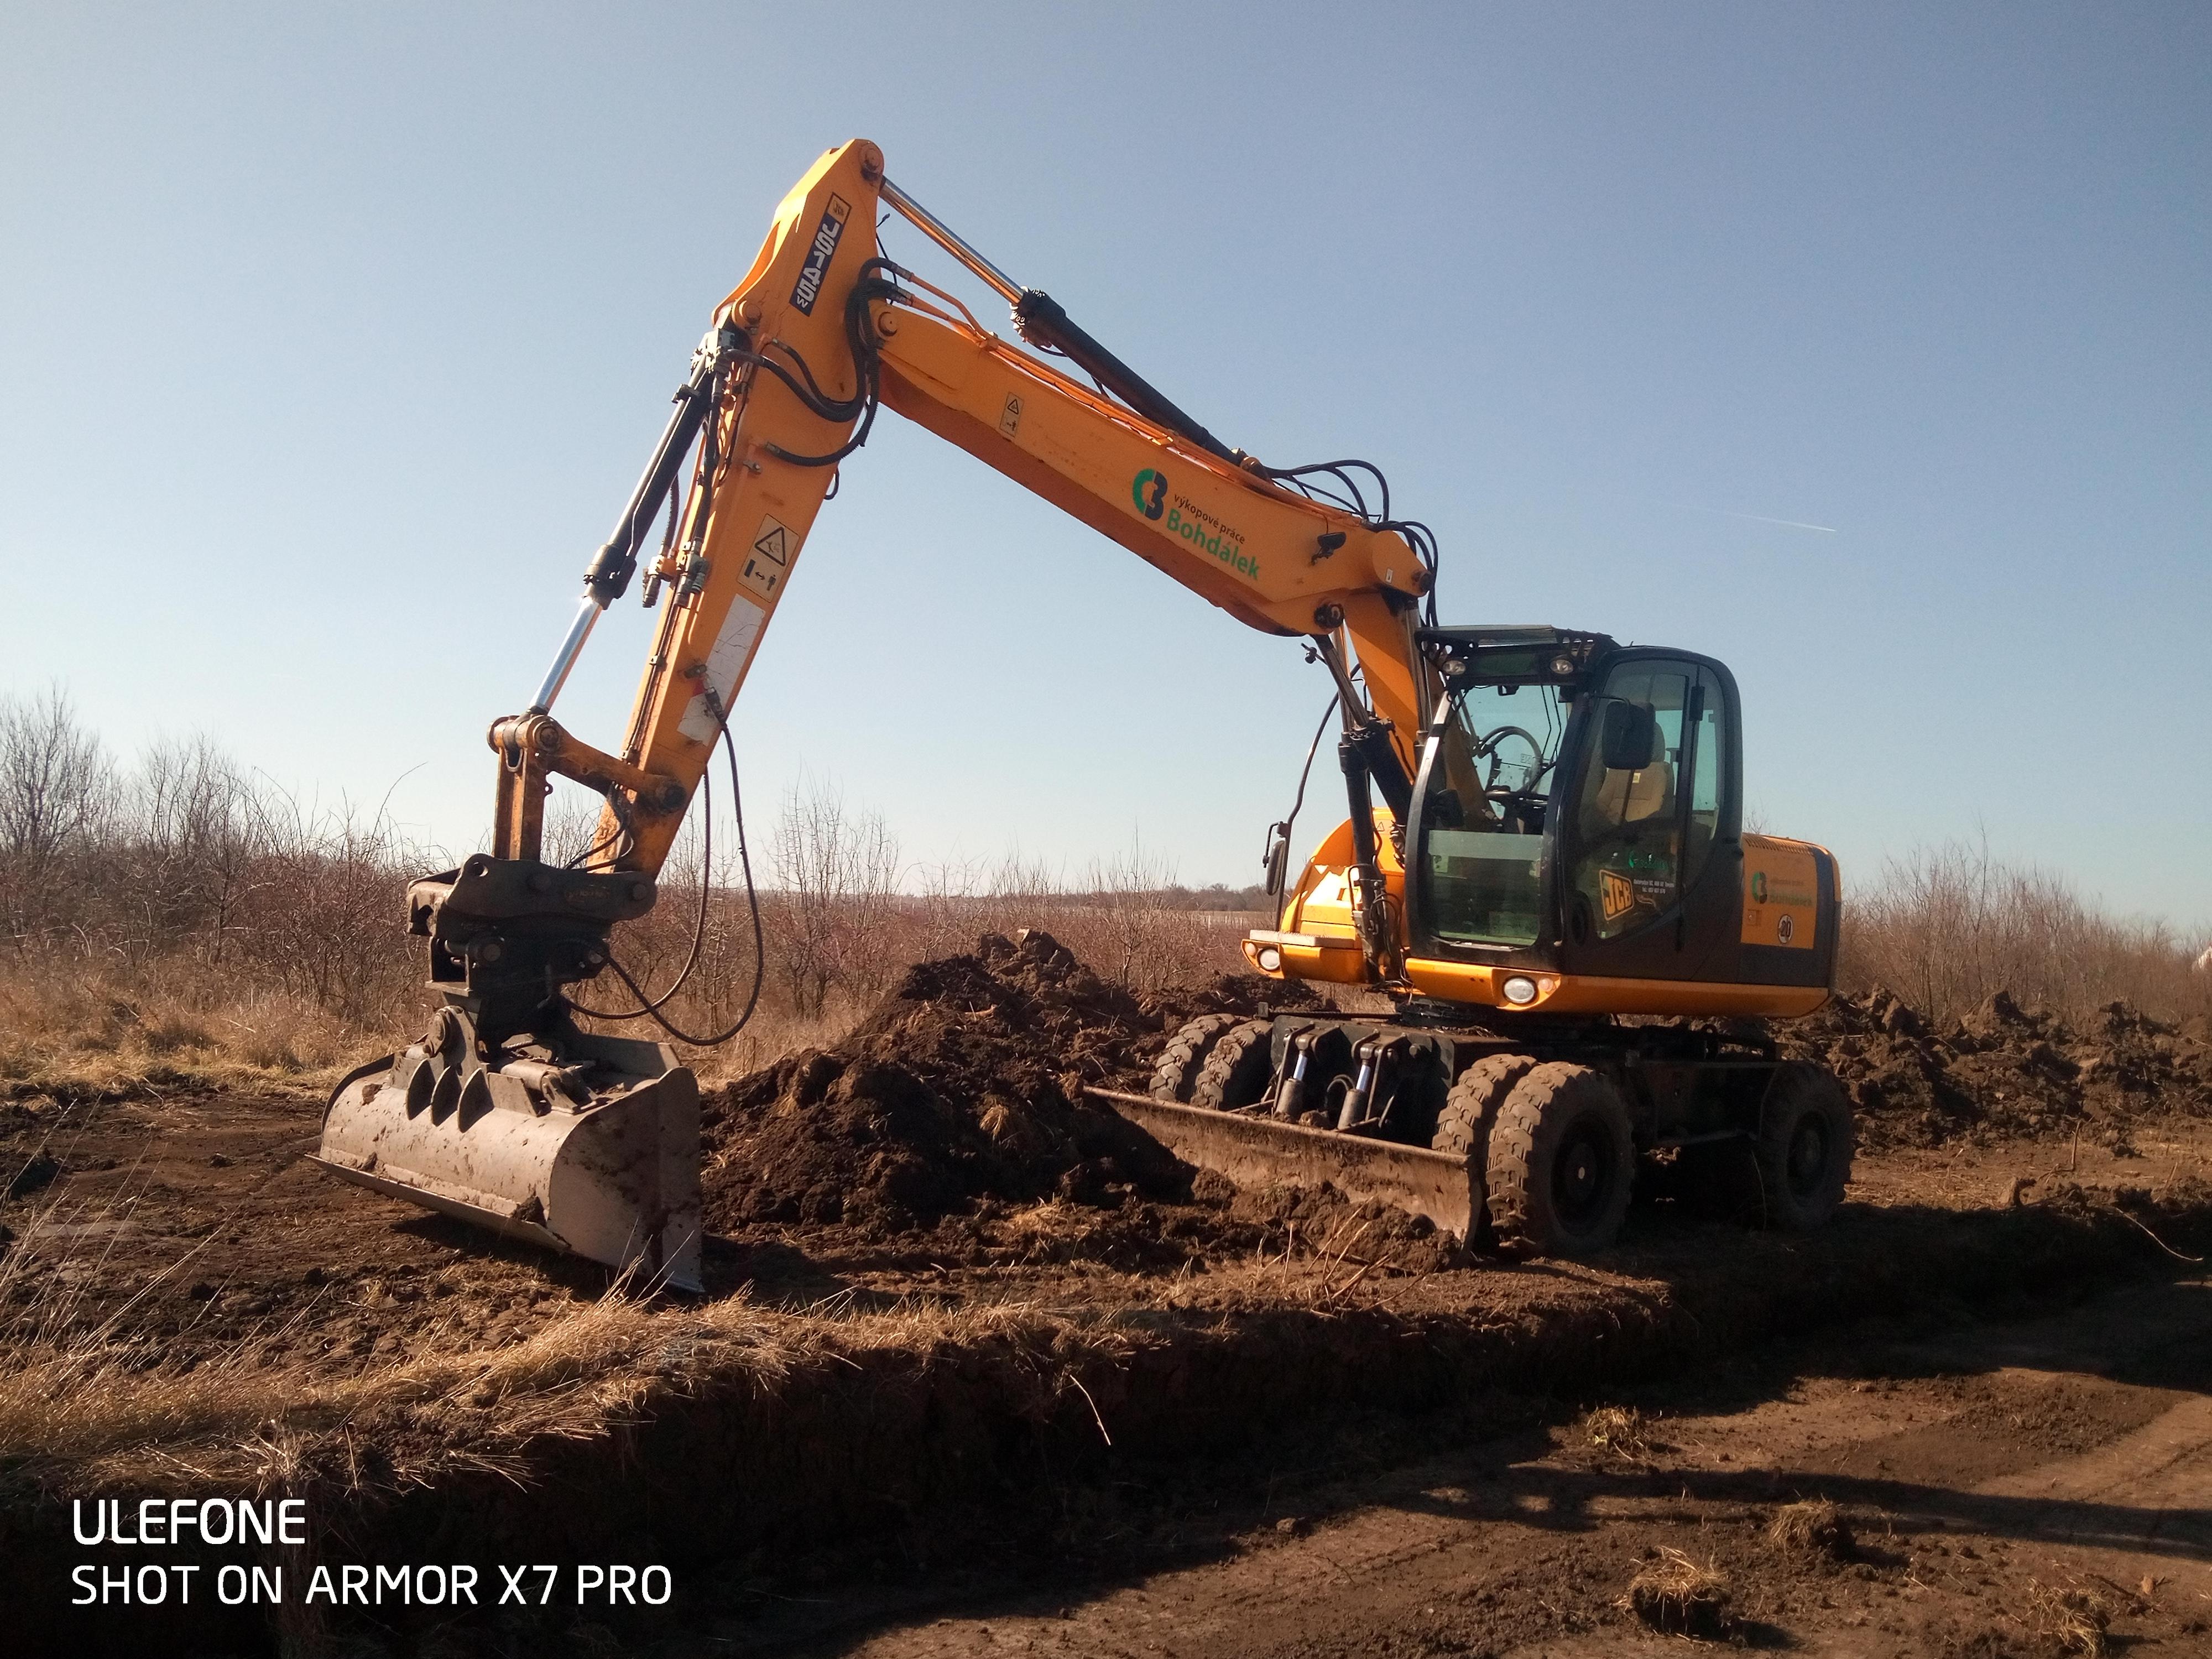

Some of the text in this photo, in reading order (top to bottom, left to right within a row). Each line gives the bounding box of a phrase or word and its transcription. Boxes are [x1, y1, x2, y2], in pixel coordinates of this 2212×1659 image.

[1173, 493, 1245, 544] výkopové práce
[1166, 508, 1260, 581] Bohdálek
[1604, 874, 1632, 915] JCB
